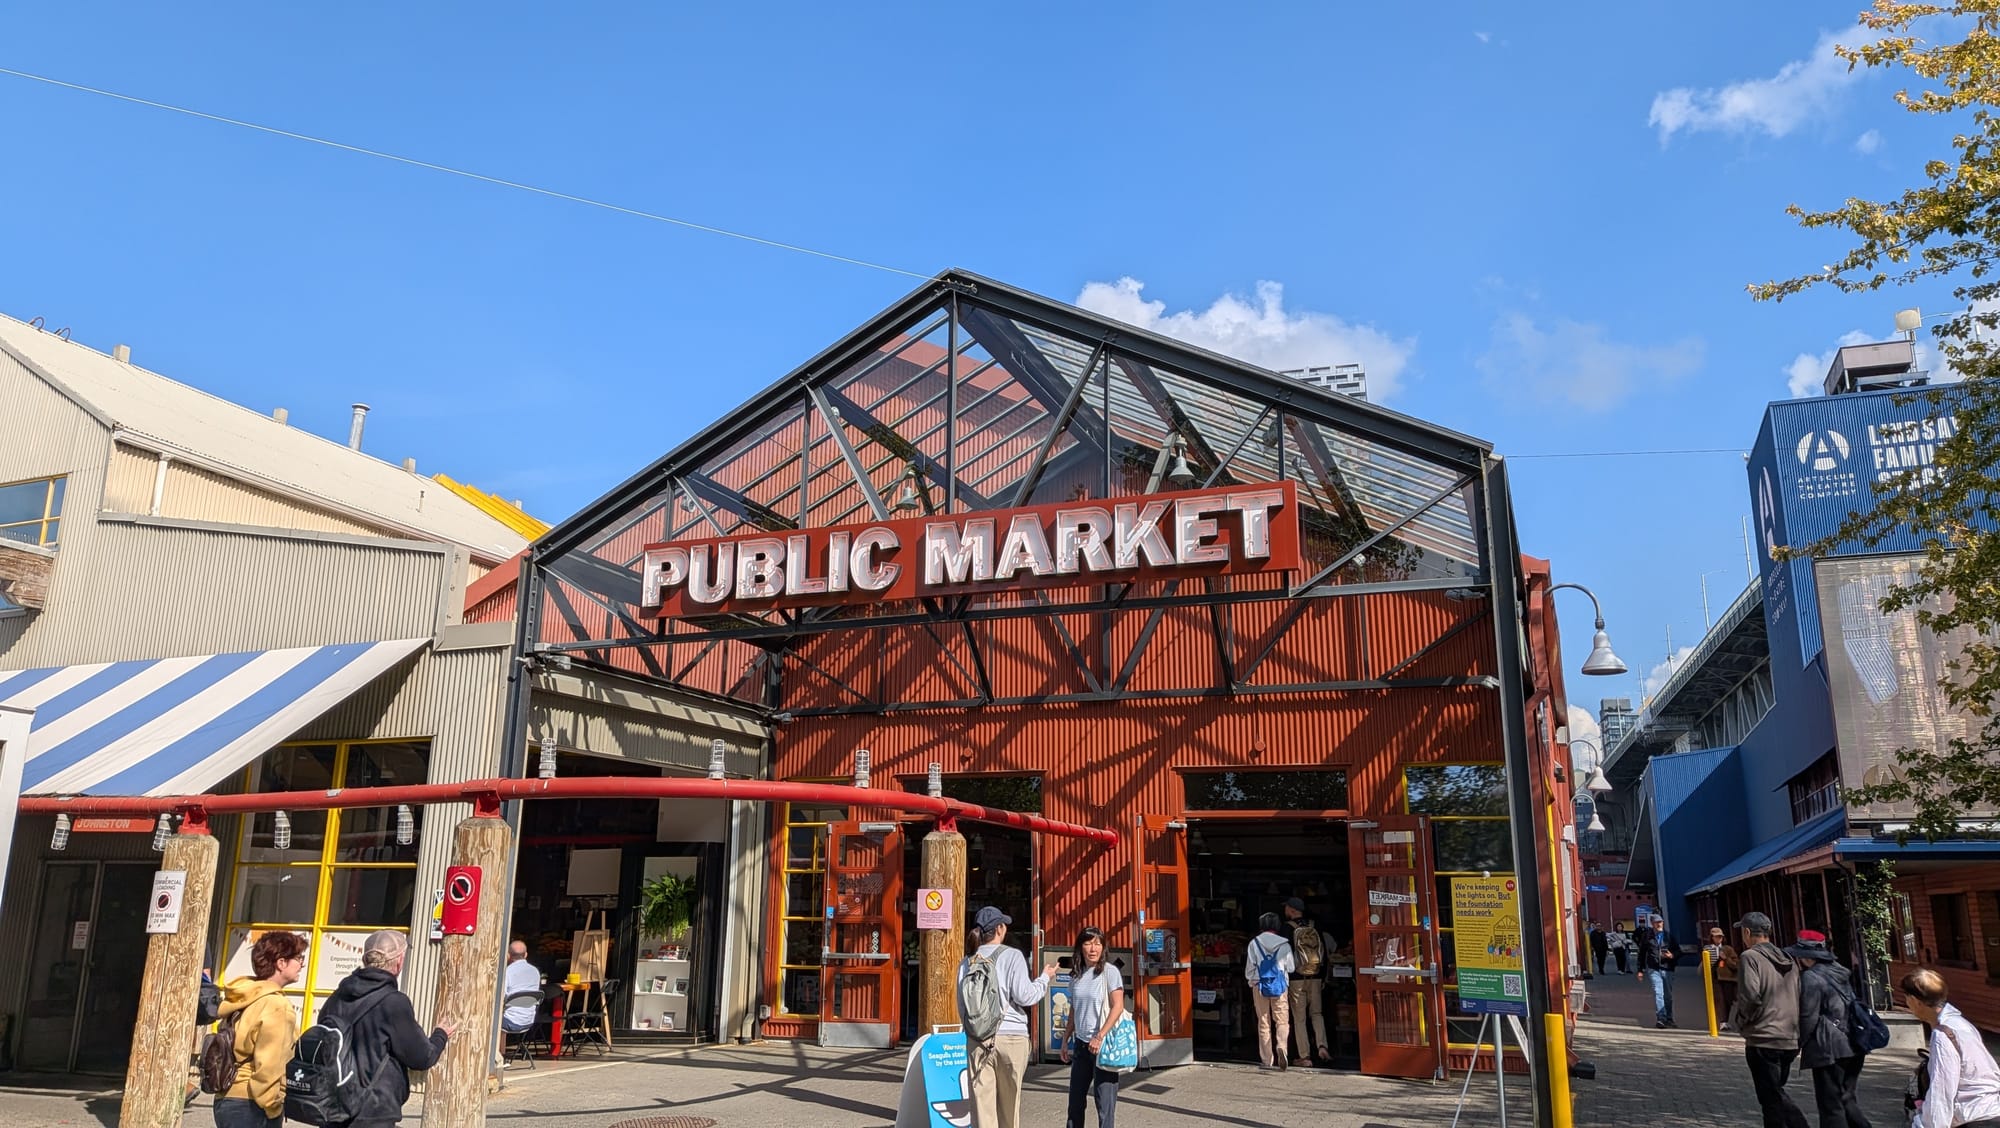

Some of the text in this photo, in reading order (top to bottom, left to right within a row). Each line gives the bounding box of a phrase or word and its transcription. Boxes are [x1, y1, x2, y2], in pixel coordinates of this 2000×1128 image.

[1873, 442, 1946, 470] FAMIL
[1799, 489, 1857, 500] COMPANY
[641, 489, 1284, 608] PUBLIC MARKET
[77, 818, 131, 829] JOHNSTON
[1474, 883, 1500, 891] keeping
[928, 1052, 951, 1060] Seagulls
